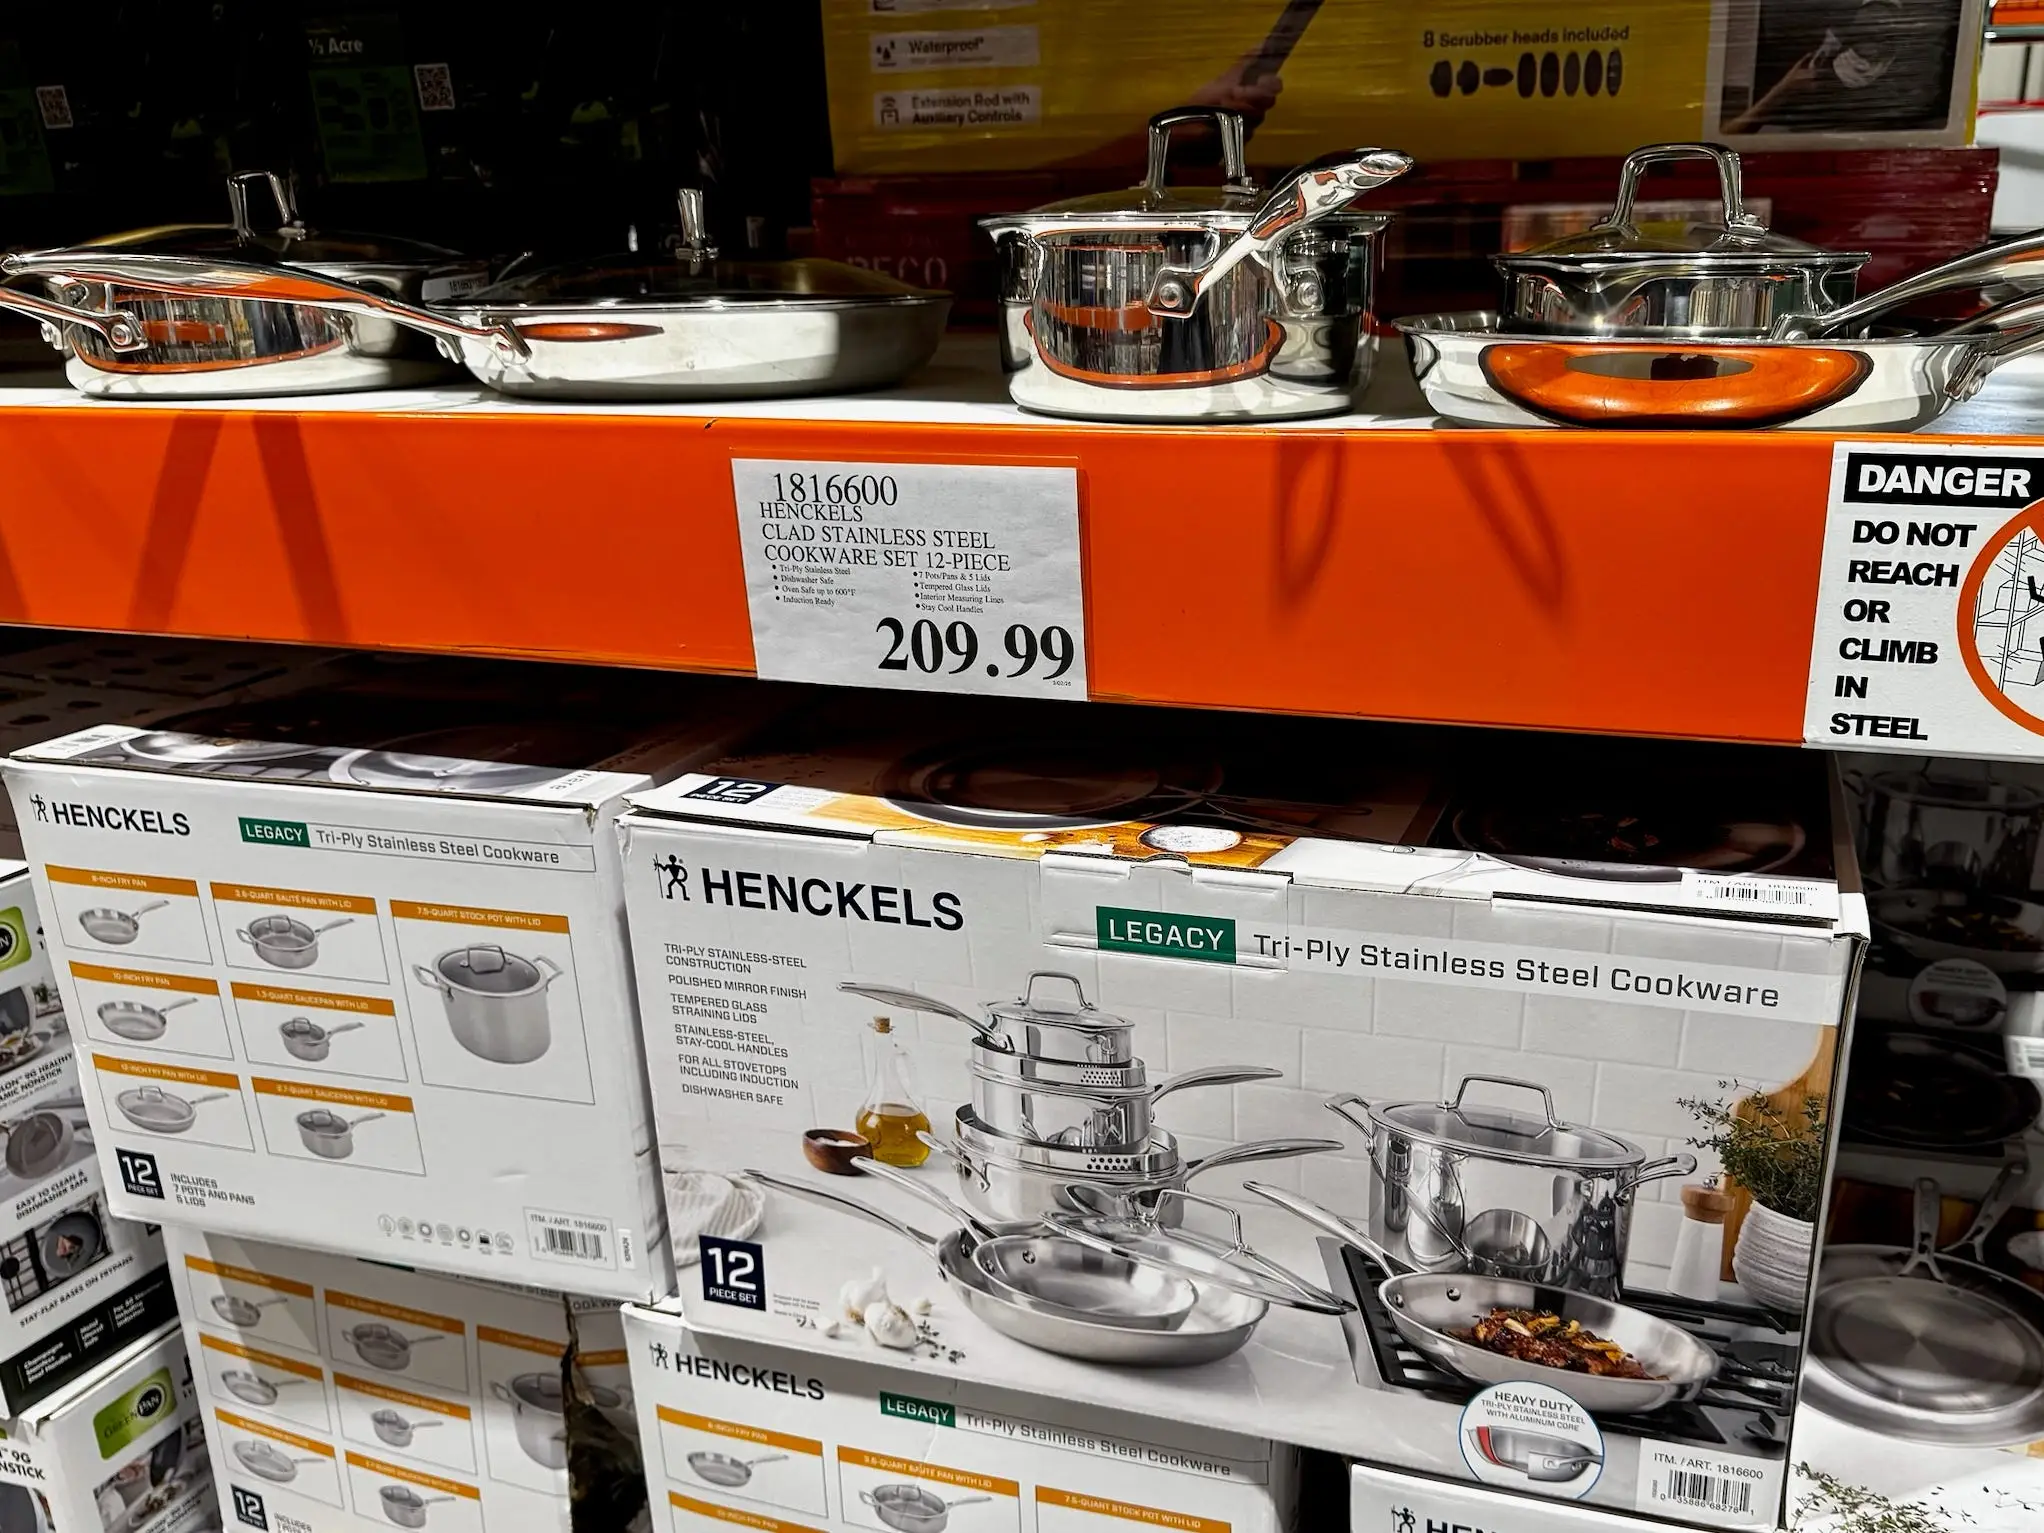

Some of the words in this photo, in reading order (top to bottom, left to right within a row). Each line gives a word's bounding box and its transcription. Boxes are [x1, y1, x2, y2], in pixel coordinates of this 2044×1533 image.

[328, 36, 364, 54] Acre
[1424, 31, 1434, 47] 8
[1440, 29, 1508, 47] Scrubber
[1512, 28, 1559, 45] heads
[1562, 26, 1629, 44] included
[911, 95, 972, 109] Extension
[974, 93, 999, 107] Rod
[1002, 92, 1030, 105] with
[912, 112, 965, 128] Auxiliary
[967, 107, 1022, 124] Controls
[773, 473, 898, 506] 1816600
[1859, 464, 2031, 498] DANGER
[760, 502, 863, 522] HENCKELS
[762, 523, 815, 542] CLAD
[822, 526, 926, 547] STAINLESS
[933, 530, 995, 549] STEEL
[1852, 520, 1899, 543] DO
[1906, 522, 1977, 547] NOT
[764, 545, 877, 566] COOKWARE
[884, 550, 919, 568] SET
[927, 552, 1011, 571] 12-PIECE
[780, 565, 804, 574] Tri-Ply
[805, 566, 833, 575] Stainless
[834, 567, 851, 575] Steel
[781, 575, 818, 584] Dishwasher
[820, 576, 834, 585] Safe
[925, 572, 958, 581] Pots/Pans
[975, 573, 991, 582] Lids
[1848, 560, 1959, 587] REACH
[782, 585, 799, 594] Oven
[801, 586, 815, 594] Safe
[817, 588, 825, 596] up
[920, 582, 954, 592] Tempered
[955, 583, 974, 592] Glass
[976, 585, 991, 593] Lids
[920, 593, 946, 601] Interior
[948, 594, 983, 604] Measuring
[985, 596, 1005, 604] Lines
[783, 596, 814, 605] Induction
[815, 597, 835, 607] Ready
[921, 603, 936, 612] Stay
[938, 603, 954, 612] Cool
[956, 605, 984, 614] Handles
[1843, 599, 1890, 623] OR
[876, 617, 1075, 681] 209.99
[1839, 638, 1938, 664] CLIMB
[1834, 675, 1868, 698] IN
[1829, 713, 1928, 740] STEEL
[706, 779, 768, 800] 12
[51, 802, 191, 836] HENCKELS
[246, 824, 303, 842] LEGACY
[316, 830, 364, 849] Tri-Ply
[368, 834, 436, 854] Stainless
[439, 841, 479, 858] Steel
[483, 845, 560, 865] Cookware
[318, 899, 338, 907] WITH
[340, 900, 352, 908] LID
[701, 867, 965, 932] HENCKELS
[459, 911, 486, 921] STOCK
[487, 913, 503, 922] POT
[504, 915, 527, 925] WITH
[527, 917, 541, 926] LID
[1109, 918, 1224, 952] LEGACY
[664, 943, 705, 957] TRI-PLY
[707, 948, 807, 968] STAINLESS-STEEL
[666, 955, 751, 974] CONSTRUCTION
[1254, 933, 1351, 967] Tri-Ply
[1360, 944, 1505, 980] Stainless
[1515, 958, 1599, 989] Steel
[1611, 968, 1780, 1008] Cookware
[668, 974, 722, 990] POLISHED
[724, 981, 768, 995] MIRROR
[770, 985, 807, 1000] FINISH
[670, 993, 730, 1009] TEMPERED
[731, 1000, 768, 1013] GLASS
[672, 1005, 731, 1021] STRAINING
[733, 1012, 757, 1024] LIDS
[675, 1024, 775, 1046] STAINLESS-STEEL,
[676, 1035, 735, 1051] STAY-COOL
[737, 1042, 789, 1058] HANDLES
[38, 1052, 73, 1073] HEALTHY
[678, 1053, 700, 1065] FOR
[702, 1057, 721, 1068] ALL
[723, 1059, 787, 1077] STOVETOPS
[20, 1067, 62, 1091] NONSTICK
[680, 1065, 737, 1082] INCLUDING
[739, 1073, 799, 1090] INDUCTION
[682, 1083, 754, 1101] DISHWASHER
[756, 1093, 784, 1106] SAFE
[121, 1155, 157, 1186] 12
[170, 1172, 218, 1189] INCLUDES
[15, 1194, 36, 1211] EASY
[38, 1187, 50, 1199] TO
[50, 1174, 76, 1192] CLEAN
[15, 1186, 69, 1220] DISHWASHER
[69, 1176, 89, 1191] SAFE
[181, 1185, 207, 1198] POTS
[207, 1189, 228, 1201] AND
[229, 1192, 256, 1206] PANS
[185, 1196, 207, 1208] LIDS
[707, 1247, 757, 1291] 12
[19, 1300, 59, 1328] STAY-FLAT
[60, 1284, 85, 1303] BASES
[85, 1275, 99, 1289] ON
[709, 1286, 738, 1302] PIECE
[738, 1292, 758, 1305] SET
[675, 1352, 825, 1401] HENCKELS
[887, 1398, 950, 1422] LEGACY
[1481, 1399, 1514, 1410] TRI-PLY
[1513, 1404, 1560, 1420] STAINLESS
[1560, 1413, 1586, 1425] STEEL
[1494, 1391, 1537, 1406] HEAVY
[1539, 1399, 1574, 1413] DUTY
[1486, 1408, 1509, 1418] WITH
[1508, 1412, 1555, 1427] ALUMINUM
[1556, 1421, 1580, 1432] CORE
[965, 1411, 1016, 1436] Tri-Ply
[1021, 1423, 1096, 1451] Stainless
[1101, 1440, 1142, 1459] Steel
[1147, 1448, 1231, 1477] Cookware
[11, 1450, 31, 1464] 9G
[1654, 1452, 1677, 1465] ITM.
[1686, 1458, 1712, 1471] ART.
[1717, 1464, 1764, 1480] 1816600
[234, 1490, 263, 1520] 12
[1111, 1503, 1141, 1516] STOCK
[1142, 1509, 1160, 1520] POT
[1161, 1514, 1185, 1526] WITH
[1185, 1518, 1201, 1529] LID
[1676, 1496, 1706, 1508] 35886
[1709, 1502, 1739, 1514] 68278
